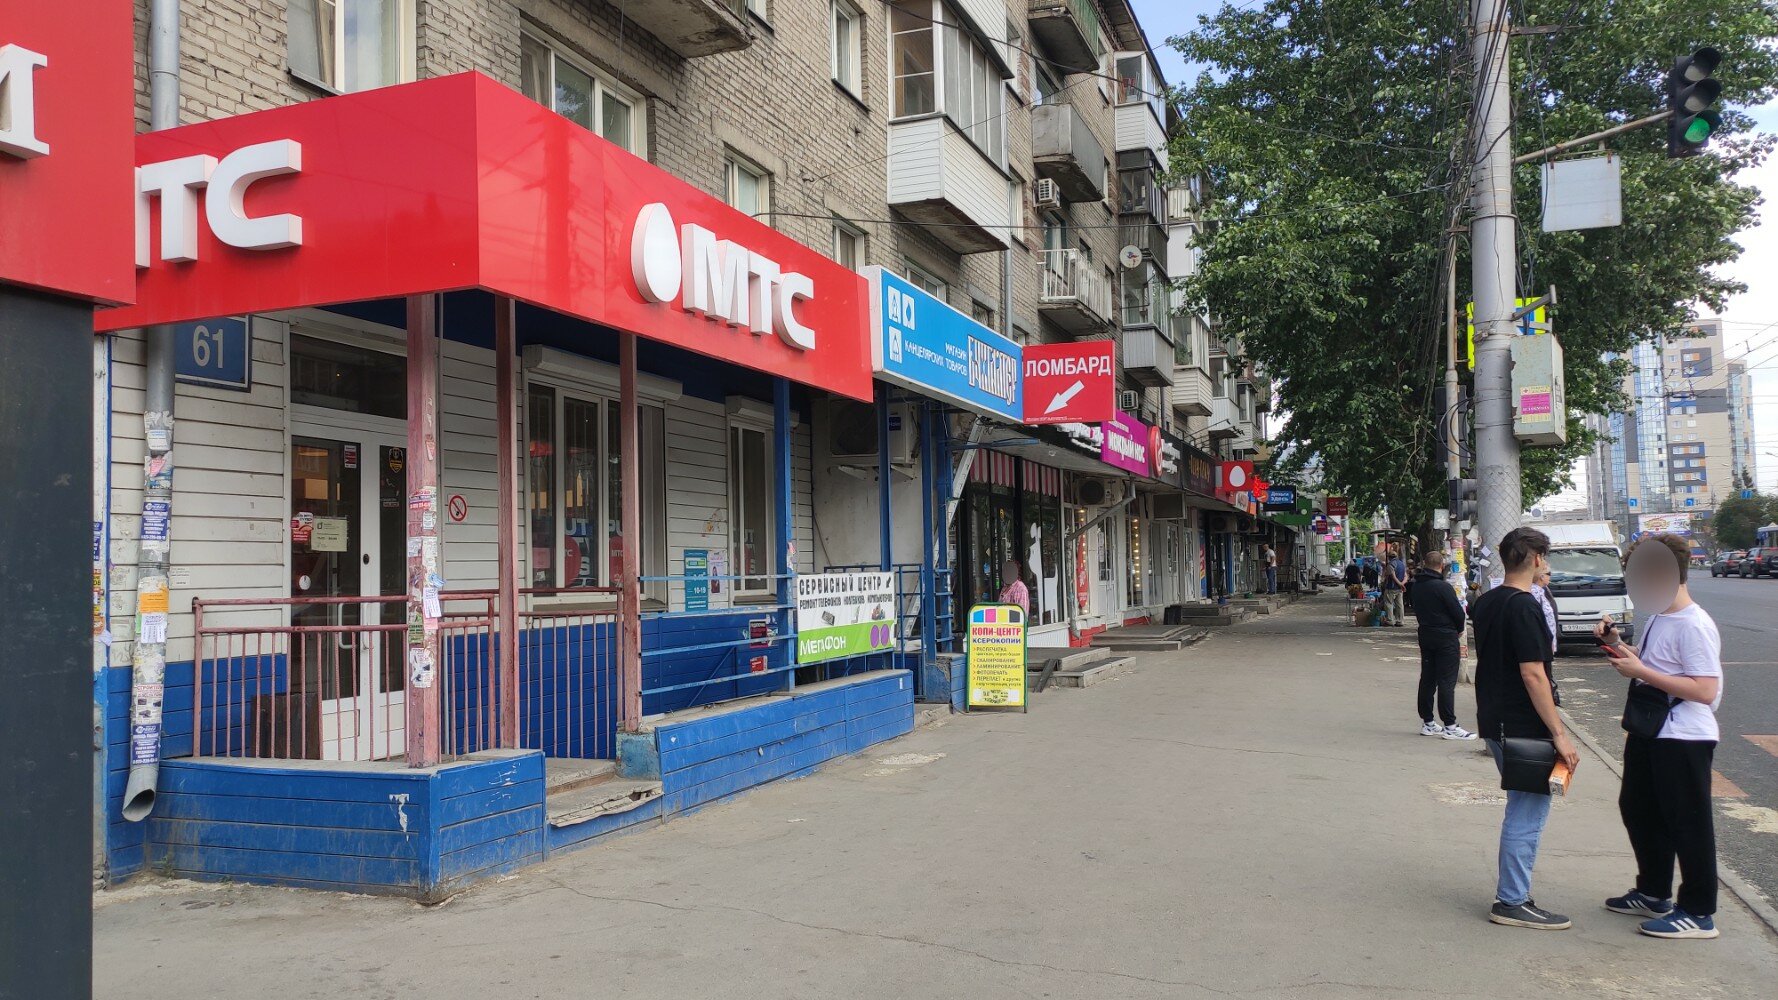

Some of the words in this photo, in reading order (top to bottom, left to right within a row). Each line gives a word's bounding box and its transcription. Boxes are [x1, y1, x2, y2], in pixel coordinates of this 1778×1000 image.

[135, 138, 302, 269] ТС
[681, 223, 816, 351] МТС
[192, 325, 225, 369] 61
[1025, 355, 1111, 377] ЛОМБАРД
[799, 574, 854, 596] СЕРВИСНЫЙ
[857, 575, 882, 593] ЦЕНТР
[799, 598, 818, 610] РЕМОНТ
[972, 627, 1022, 638] КОПИ-ЦЕНТР
